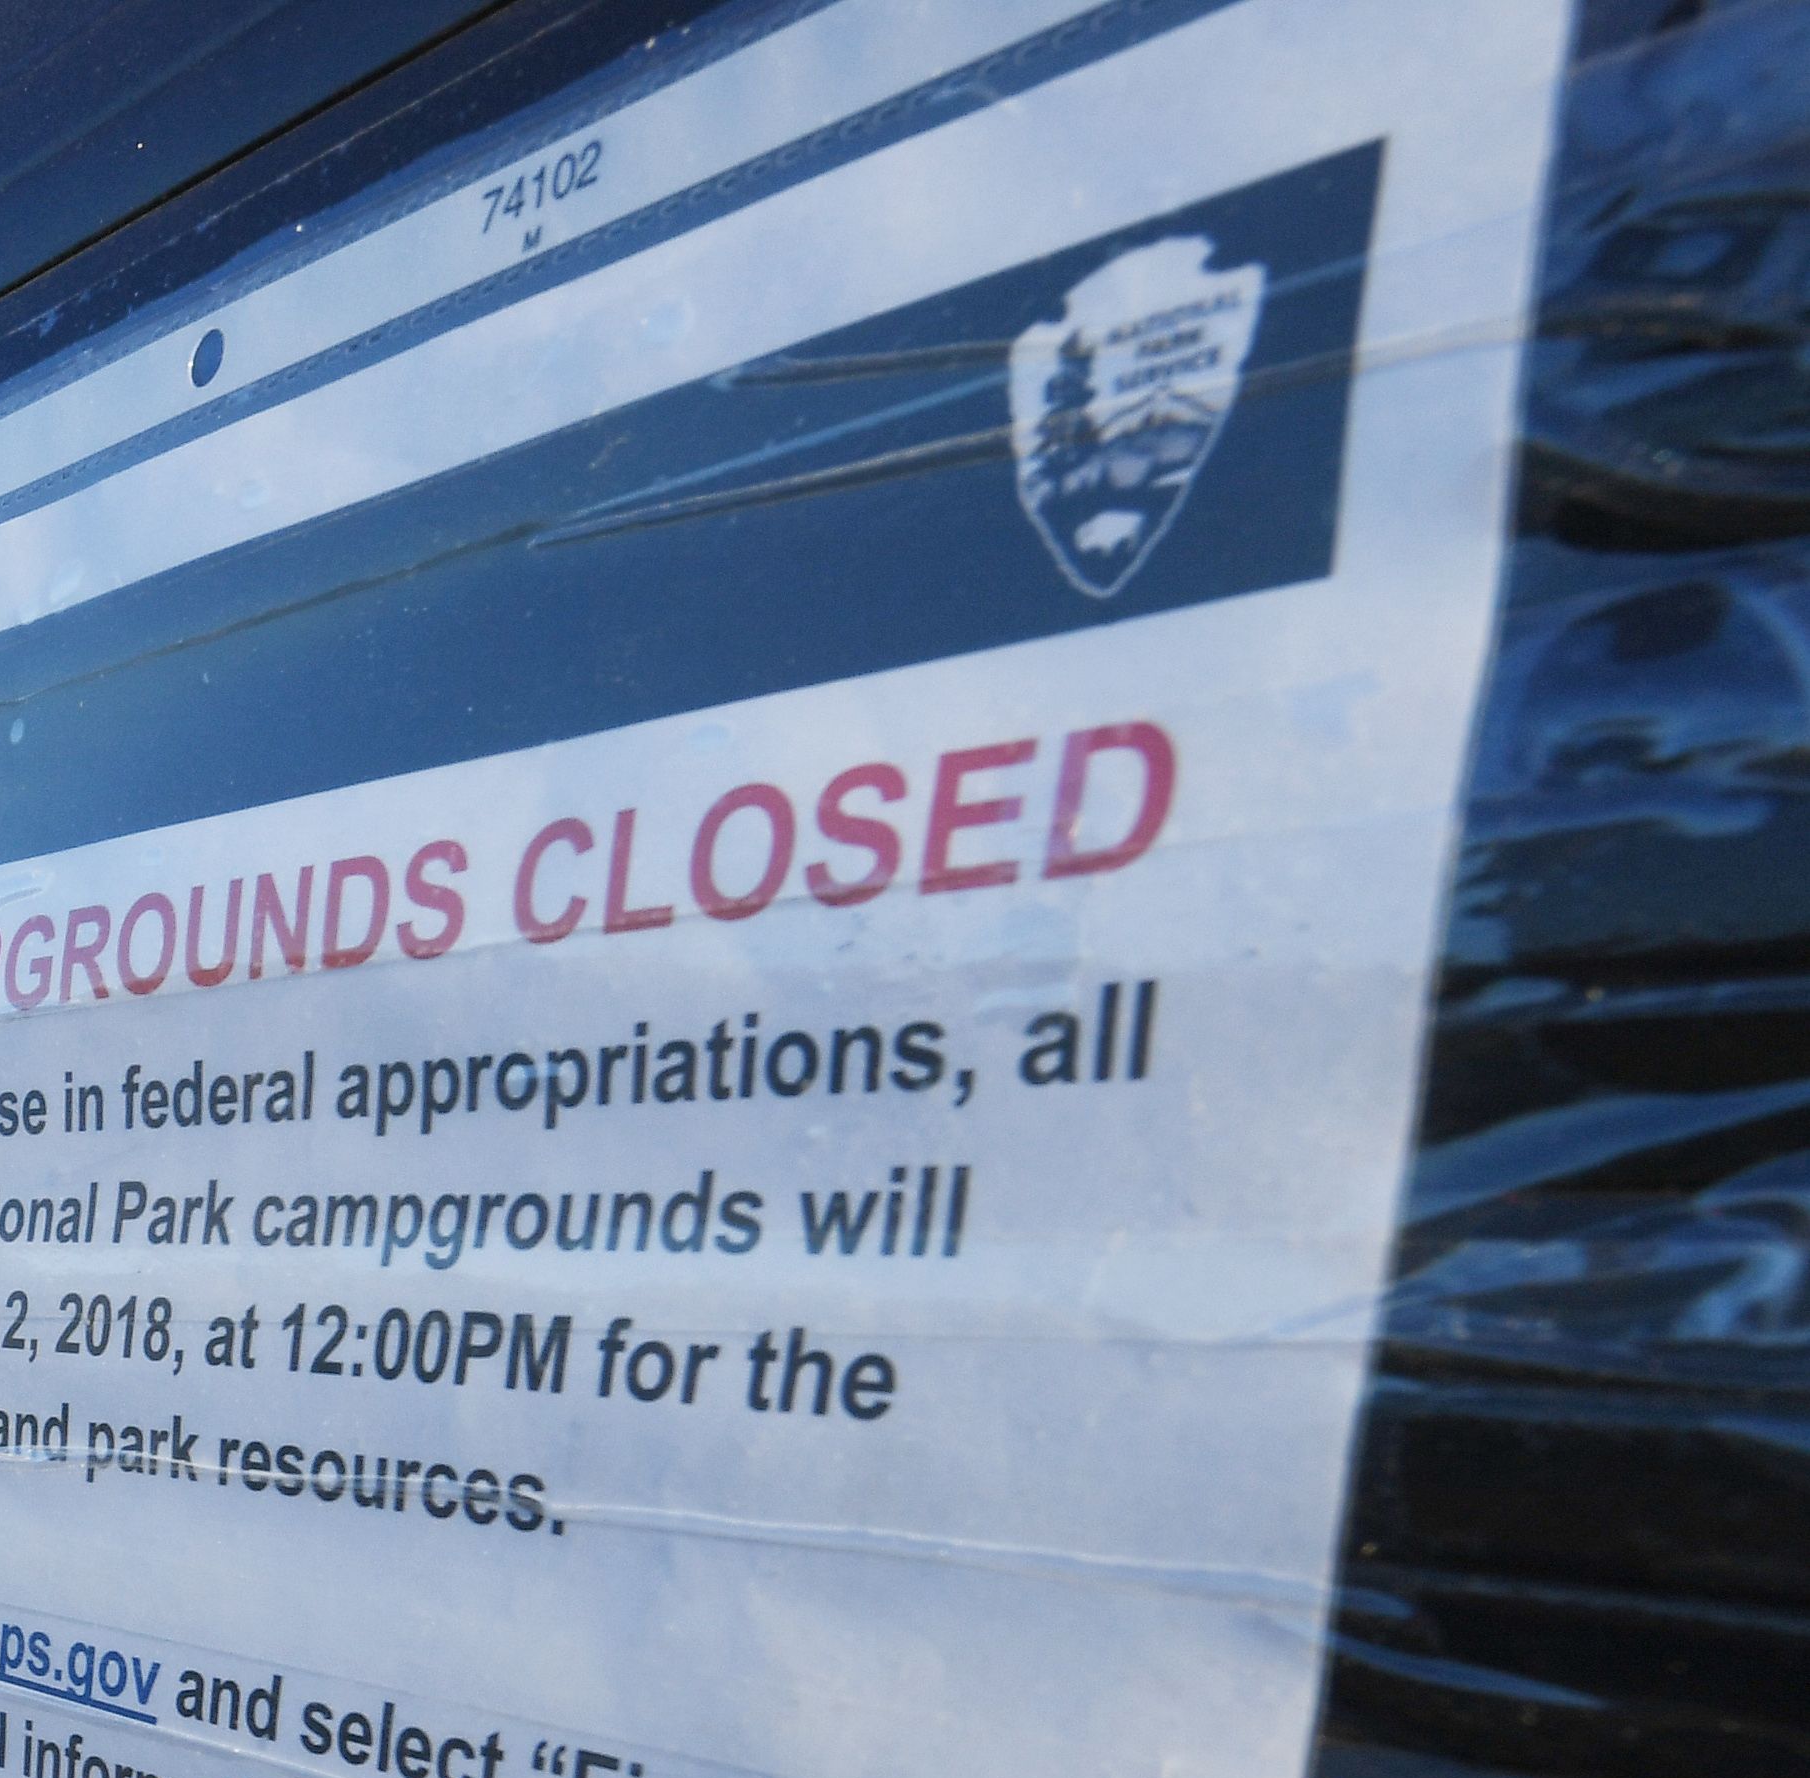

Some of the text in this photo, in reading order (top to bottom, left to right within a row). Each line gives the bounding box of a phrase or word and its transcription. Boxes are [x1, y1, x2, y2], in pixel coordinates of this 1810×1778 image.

[483, 140, 602, 233] 74102
[512, 719, 1178, 946] CLOSED
[63, 1073, 104, 1134] in
[122, 1050, 314, 1131] federal
[337, 1013, 976, 1135] appropriations,
[1017, 979, 1160, 1087] all
[113, 1179, 235, 1246] Park
[252, 1170, 765, 1270] campgrounds
[799, 1164, 972, 1258] will
[2, 1290, 40, 1363] 2,
[55, 1292, 184, 1375] 2018,
[203, 1306, 259, 1371] at
[281, 1303, 572, 1395] 12:00PM
[596, 1316, 720, 1403] for
[747, 1326, 898, 1421] the
[86, 1415, 199, 1485] park
[217, 1431, 567, 1536] resources.
[175, 1667, 282, 1742] and
